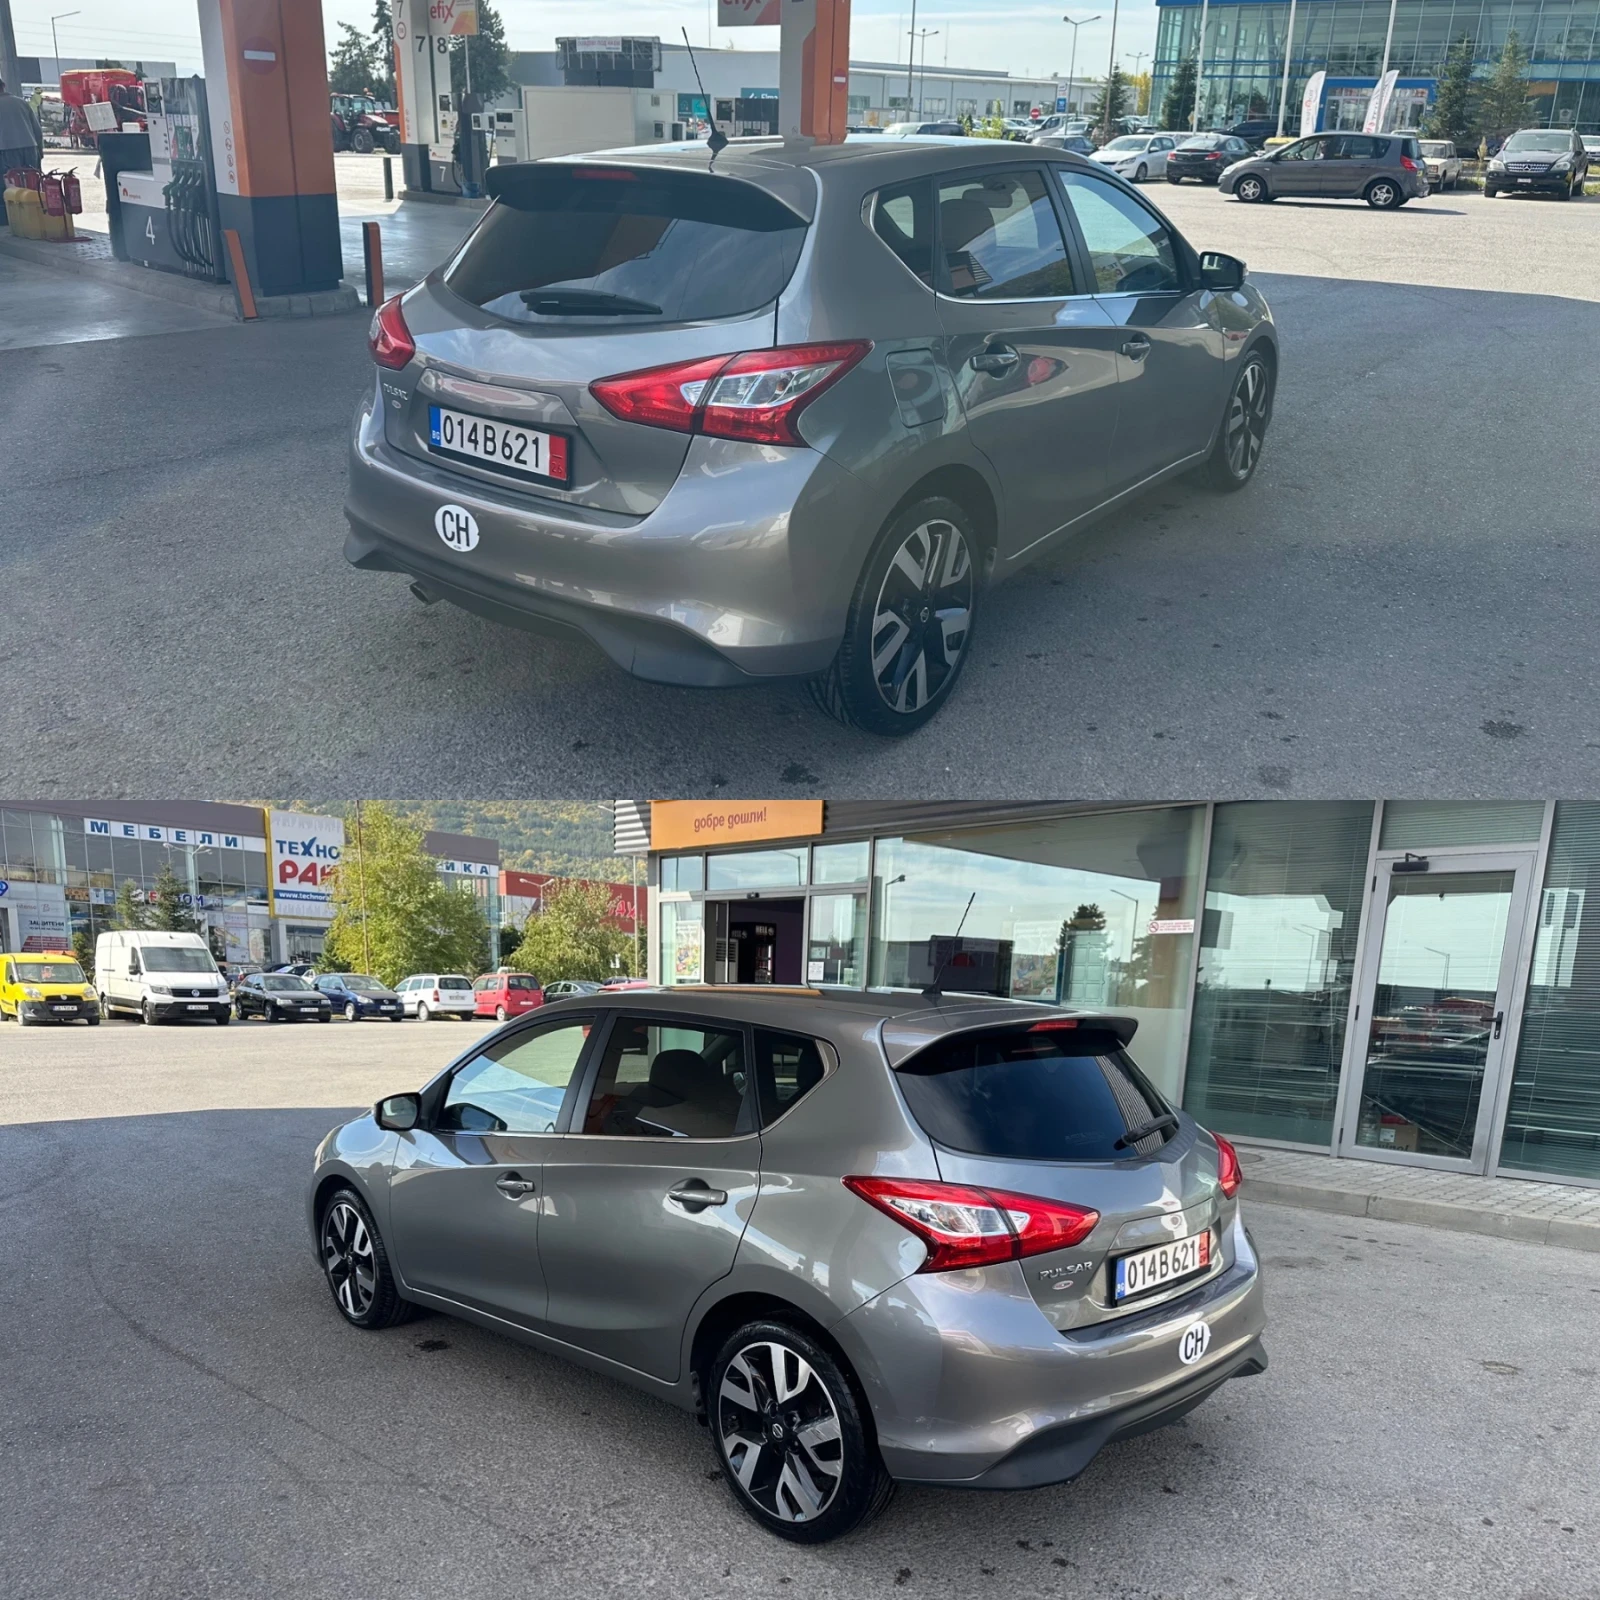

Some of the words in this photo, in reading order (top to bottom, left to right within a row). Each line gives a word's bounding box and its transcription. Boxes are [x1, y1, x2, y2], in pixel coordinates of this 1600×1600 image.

[430, 0, 455, 24] efix
[415, 35, 426, 53] 7
[437, 36, 448, 54] 8
[439, 165, 446, 182] 7
[145, 215, 155, 245] 4
[441, 510, 470, 547] CH
[694, 813, 725, 833] добре
[727, 806, 767, 829] дошли!
[90, 820, 238, 848] МЕБЕЛИ
[275, 836, 341, 860] ТЕХНО
[1039, 1261, 1093, 1281] PULSAR
[1184, 1326, 1204, 1361] CH
